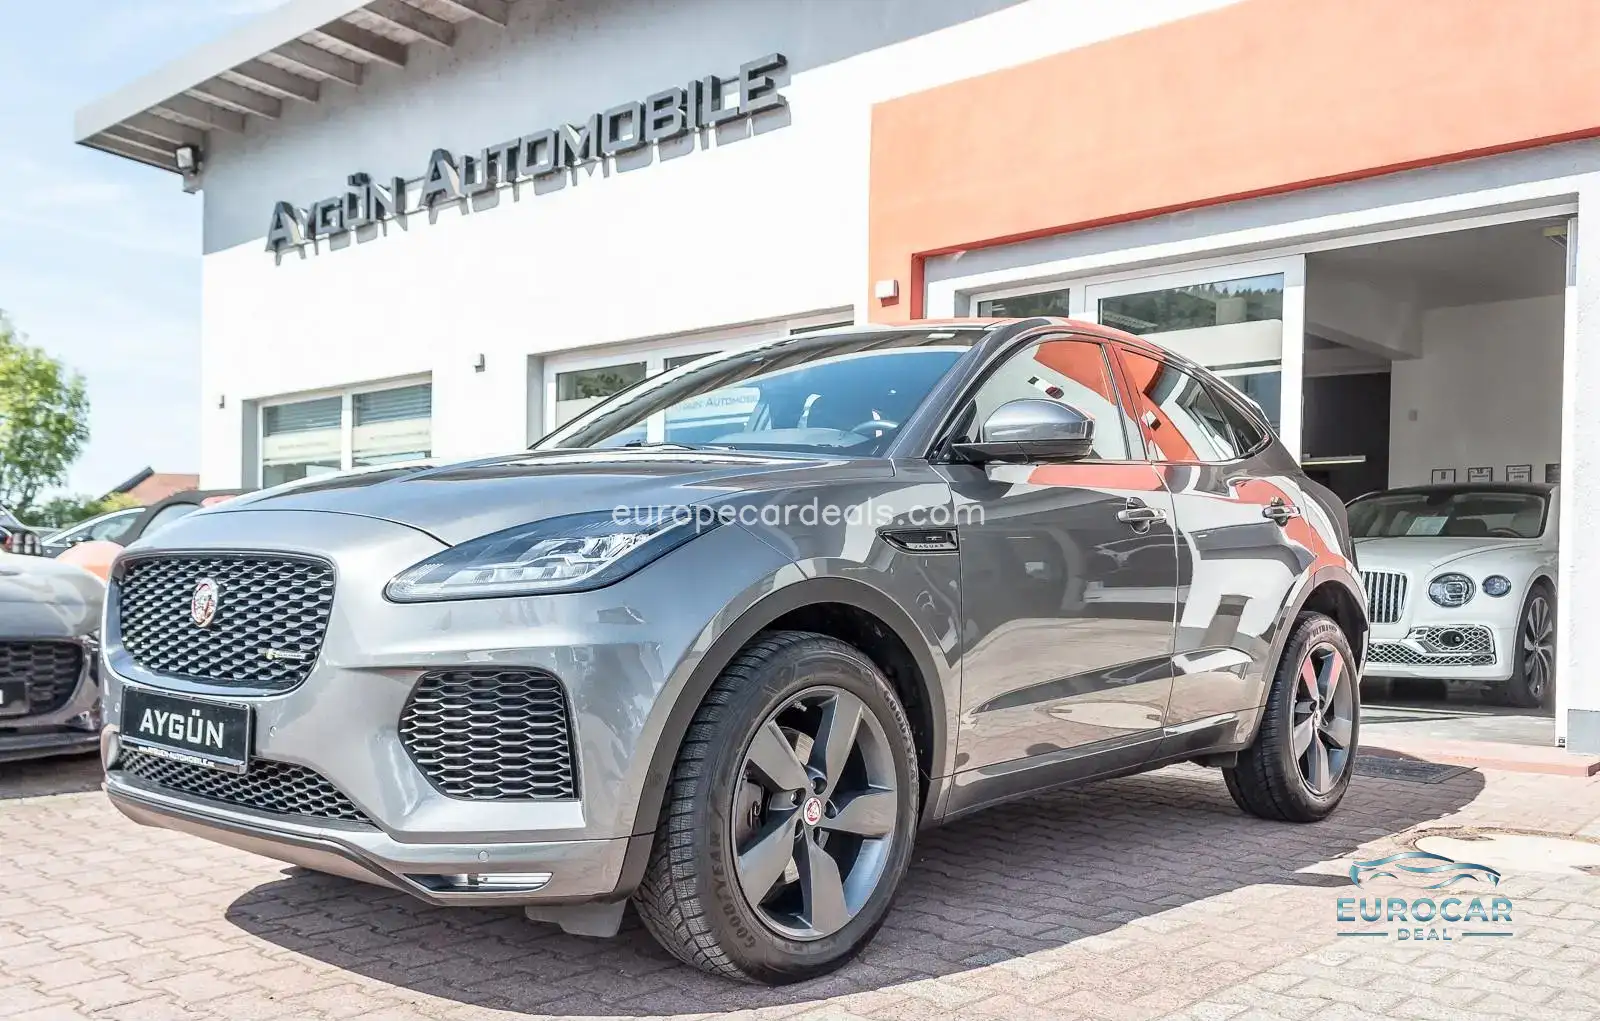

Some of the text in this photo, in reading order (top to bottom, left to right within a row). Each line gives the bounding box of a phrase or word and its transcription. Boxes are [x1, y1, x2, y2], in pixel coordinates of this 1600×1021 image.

[265, 52, 788, 252] AYGÜN AUTOMOBILE
[139, 708, 225, 749] AYGÜN
